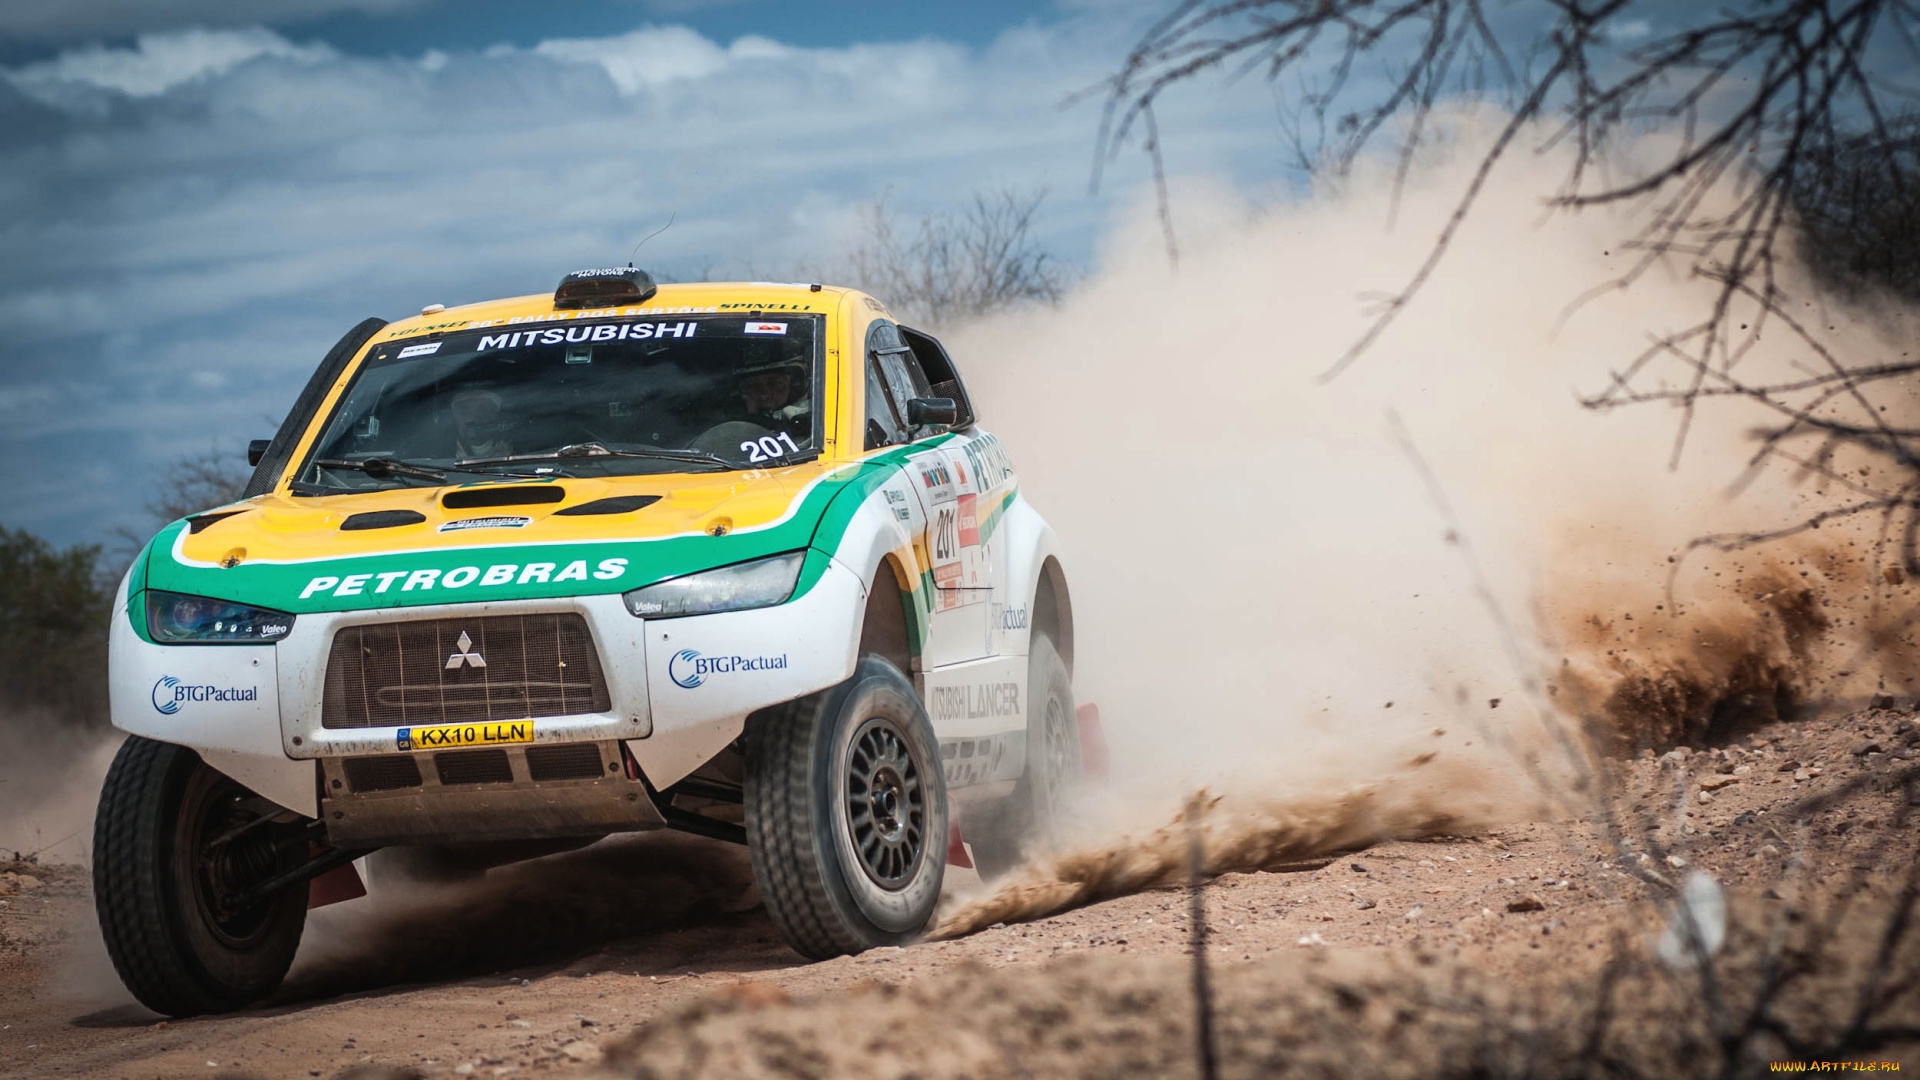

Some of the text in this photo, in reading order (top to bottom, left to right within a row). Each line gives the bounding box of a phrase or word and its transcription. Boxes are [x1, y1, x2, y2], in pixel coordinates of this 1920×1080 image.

[577, 270, 625, 278] MOTORS
[508, 313, 570, 325] RALLY
[577, 308, 617, 319] DOS
[719, 303, 811, 311] SPINELLI
[389, 320, 470, 338] YOUSSEF
[476, 322, 697, 352] MITSUBISHI
[740, 431, 800, 463] 201
[936, 508, 956, 559] 201
[299, 557, 630, 600] PETROBRAS
[634, 601, 662, 613] Valeo
[261, 624, 288, 637] Valeo
[695, 653, 788, 674] BTGPactual
[174, 684, 258, 703] BTGPactual
[967, 682, 1021, 719] LANCER
[421, 724, 525, 745] KX10 LLN
